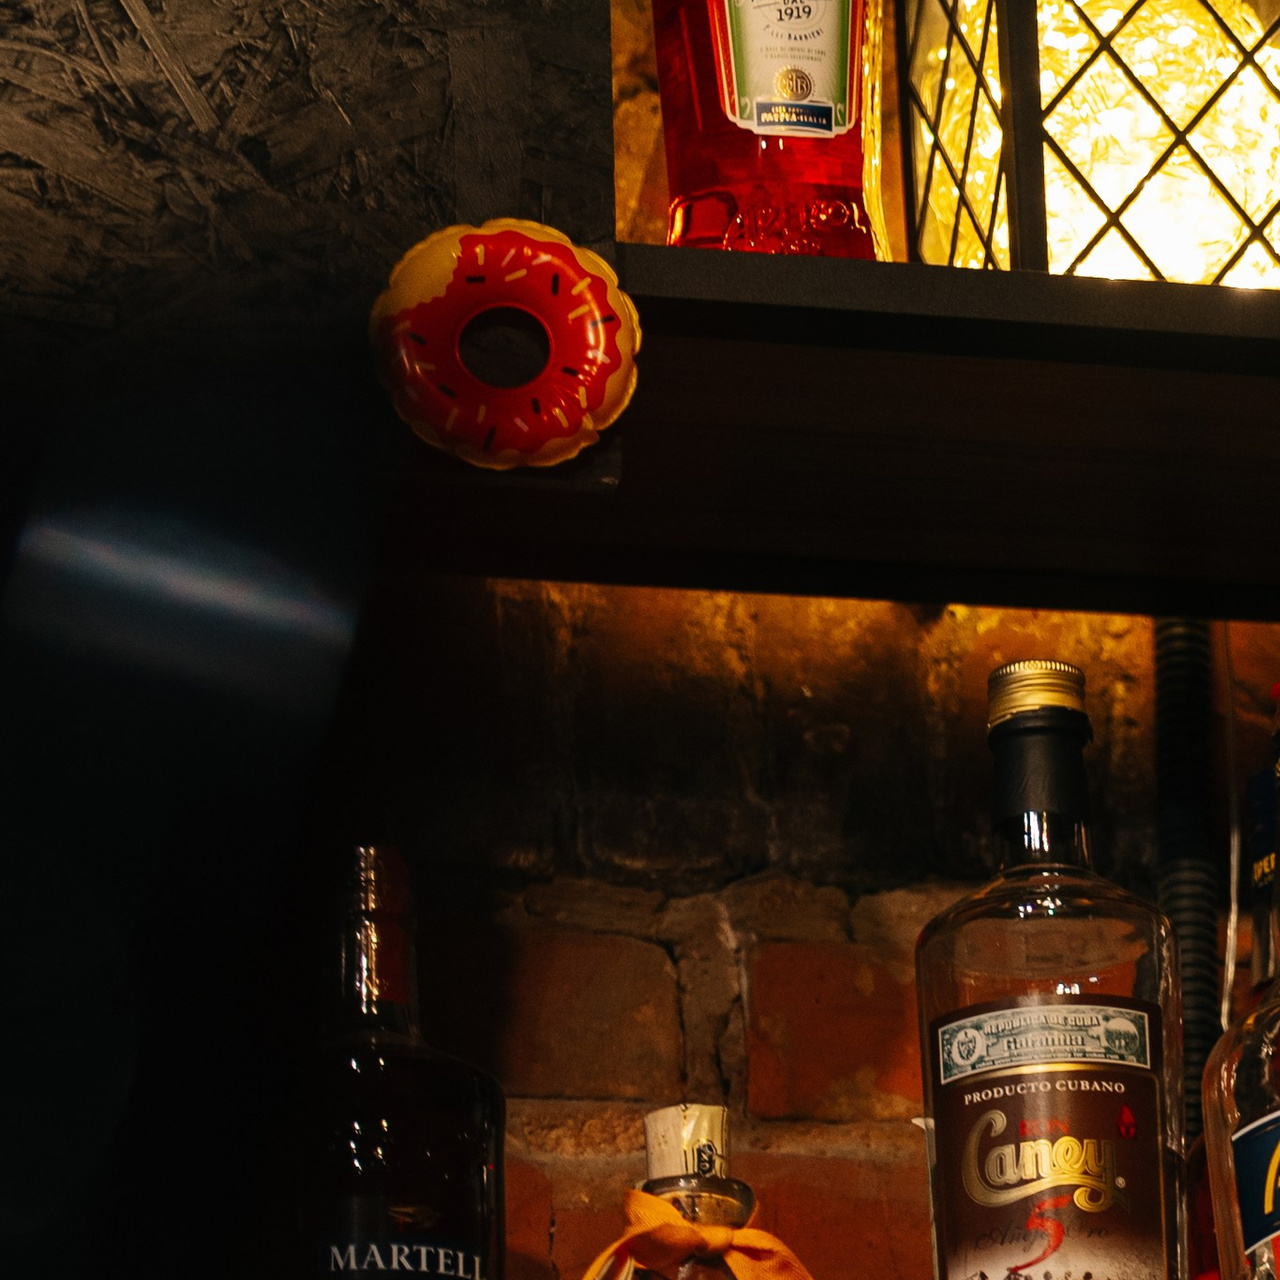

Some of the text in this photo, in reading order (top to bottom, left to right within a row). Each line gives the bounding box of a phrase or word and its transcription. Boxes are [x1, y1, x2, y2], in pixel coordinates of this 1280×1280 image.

[777, 5, 812, 22] 1919
[963, 1079, 1126, 1106] PRODUCTO CUBANO
[961, 1109, 1118, 1215] Caney
